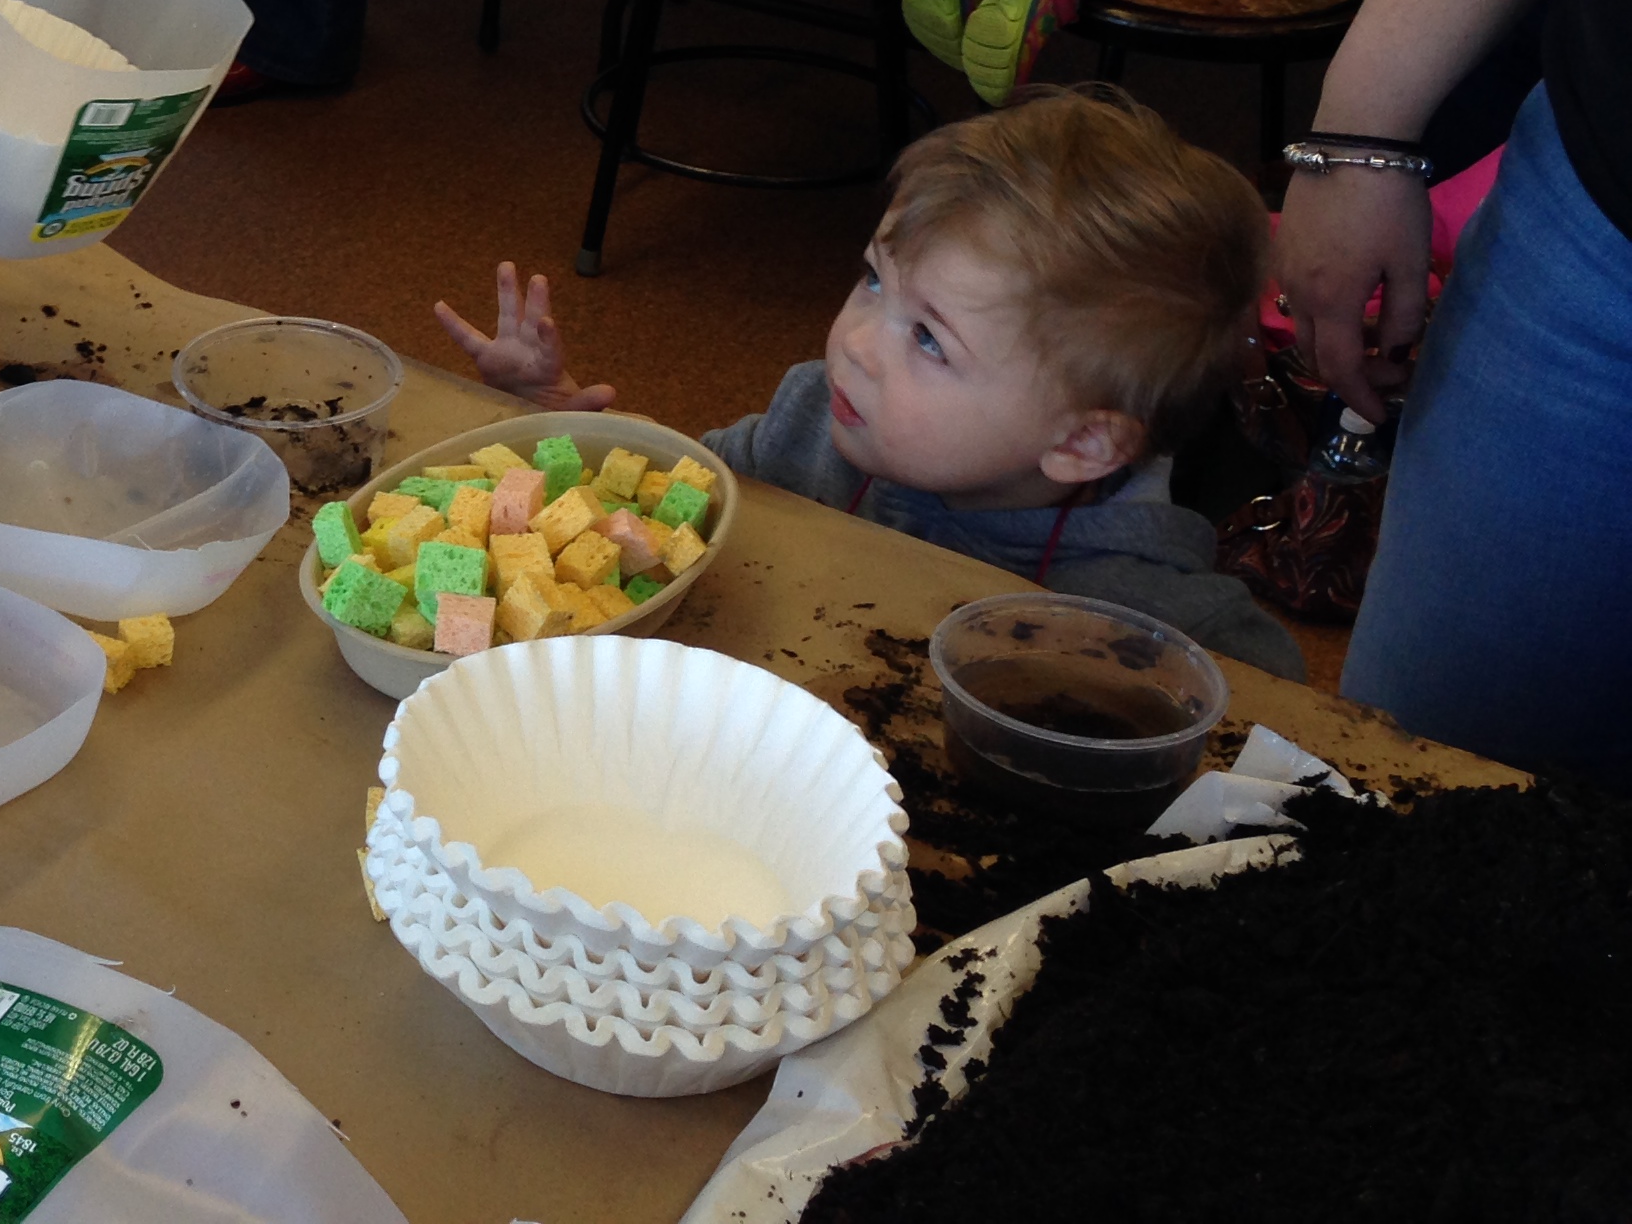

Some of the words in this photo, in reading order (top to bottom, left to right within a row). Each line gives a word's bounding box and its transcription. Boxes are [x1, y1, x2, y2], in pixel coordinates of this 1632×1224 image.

[112, 1037, 130, 1052] OZ
[127, 1044, 141, 1059] FL
[95, 1043, 122, 1064] (3.79
[136, 1052, 157, 1071] 128
[119, 1057, 141, 1077] GAL
[137, 1071, 147, 1082] 1
[1, 1077, 33, 1094] carefully
[33, 1091, 51, 1102] from
[8, 1132, 37, 1153] 1845
[11, 1144, 23, 1157] Est.
